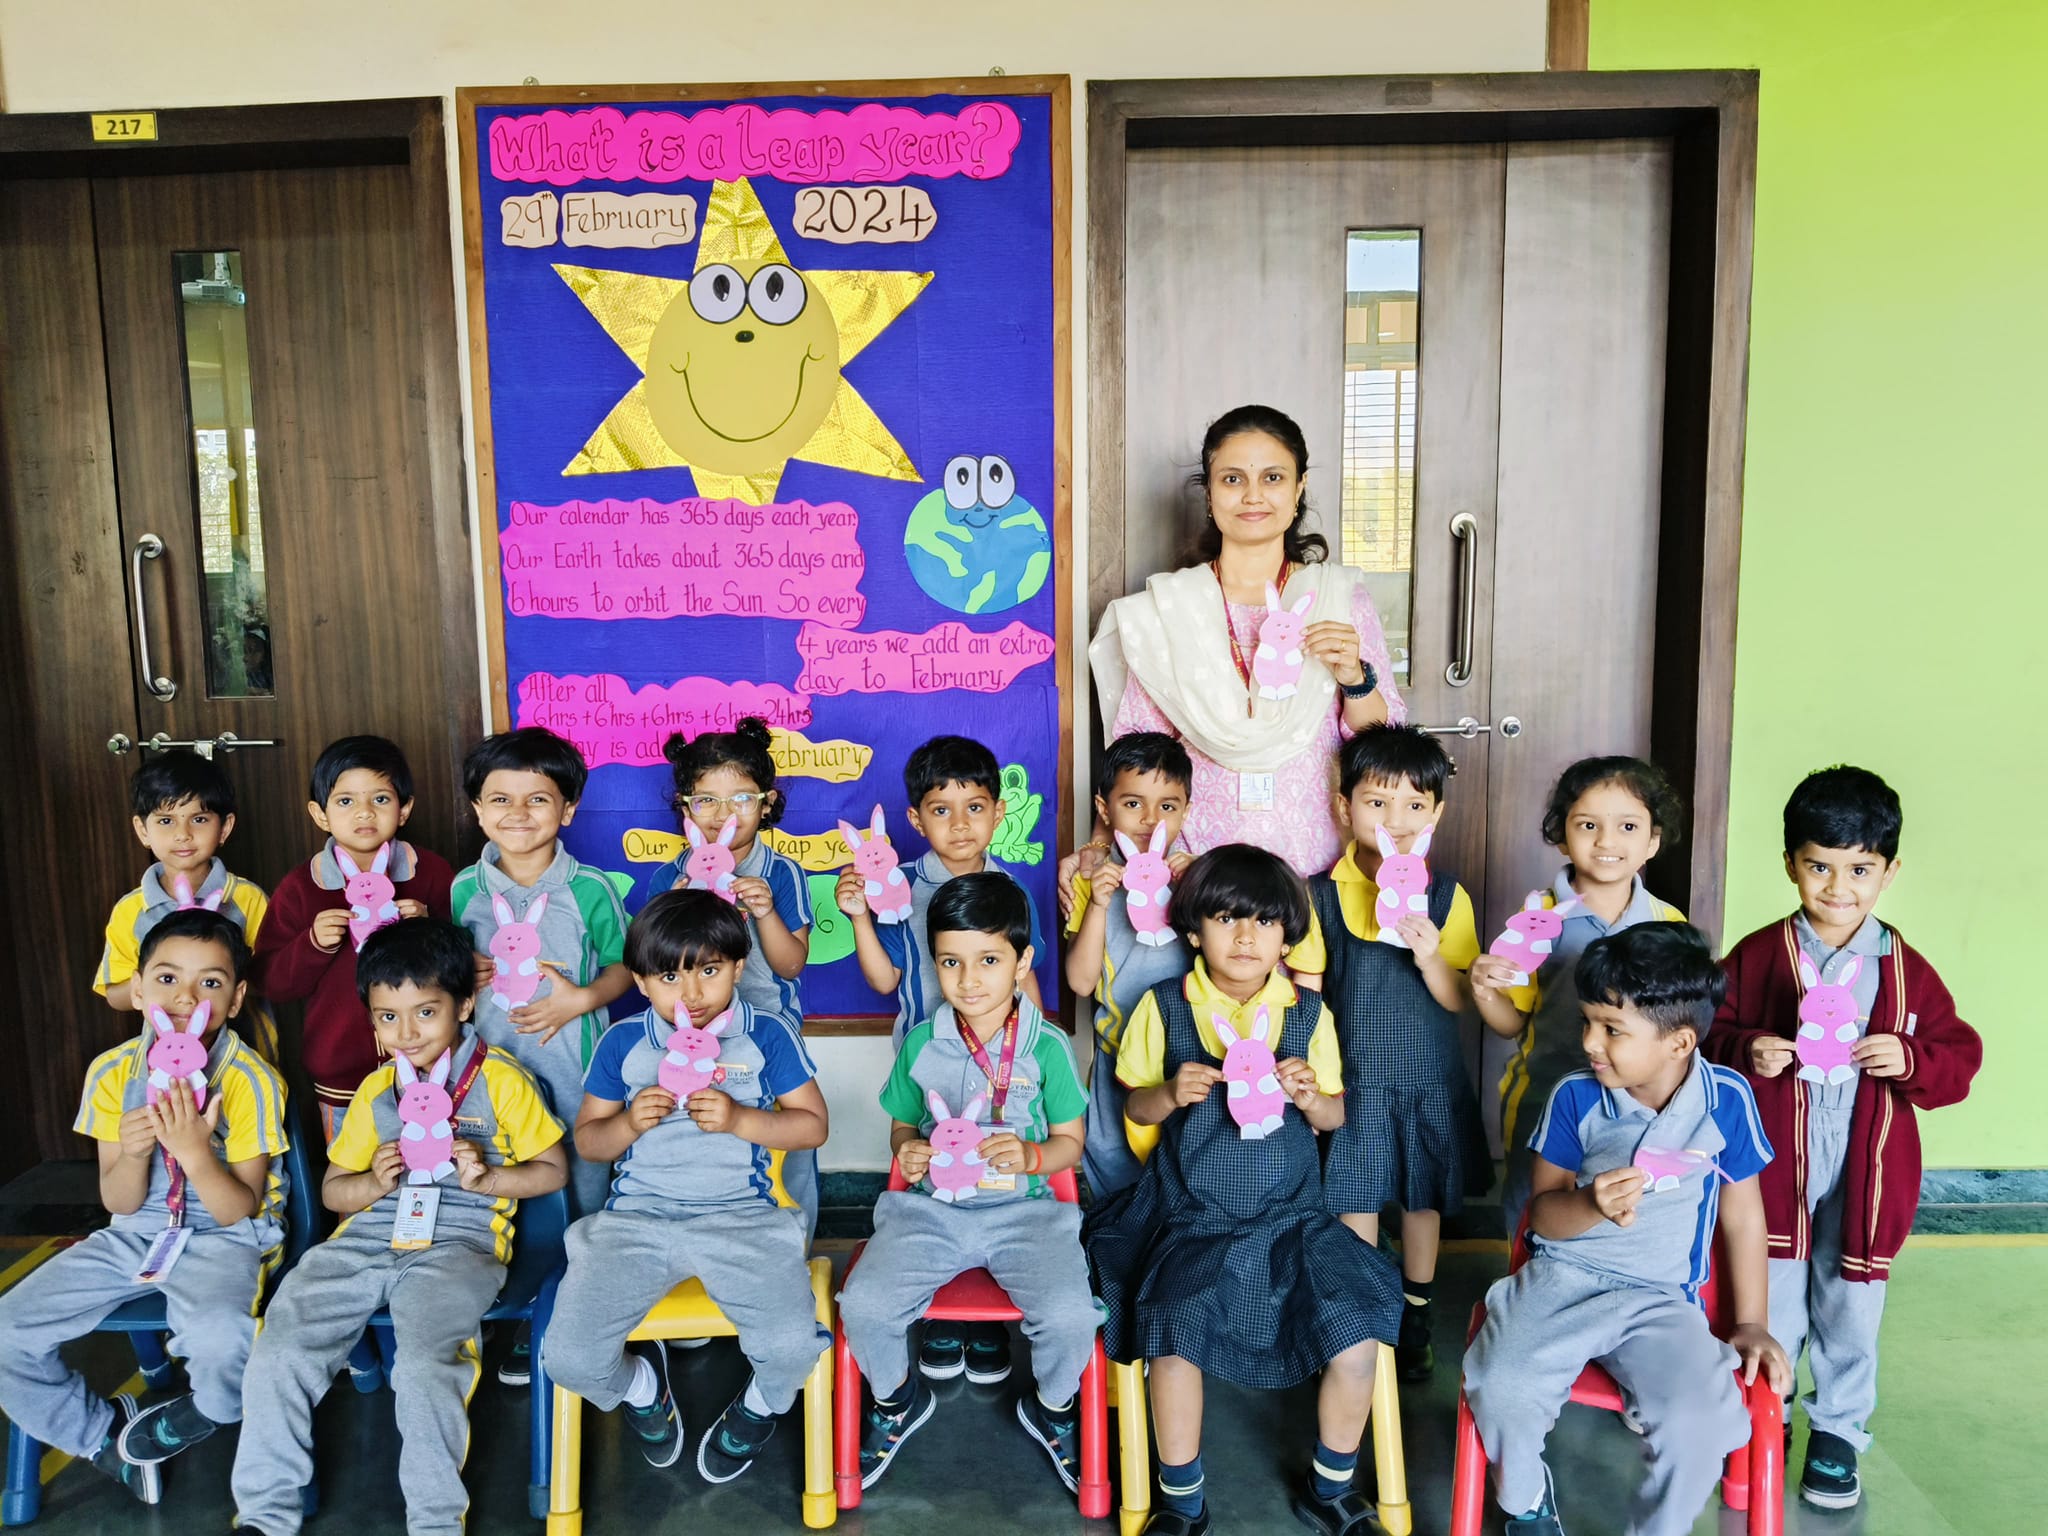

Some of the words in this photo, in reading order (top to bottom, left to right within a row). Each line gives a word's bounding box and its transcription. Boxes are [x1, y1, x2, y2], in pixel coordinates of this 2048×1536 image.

[106, 119, 142, 135] 217
[491, 117, 618, 173] What
[638, 127, 685, 173] is
[698, 134, 725, 170] a
[852, 104, 1003, 183] year?
[565, 197, 688, 246] February
[802, 187, 933, 239] 2024
[511, 502, 548, 526] Our
[559, 501, 630, 525] calendar
[640, 501, 670, 525] has
[679, 501, 719, 526] 365
[723, 502, 765, 534] days
[771, 503, 810, 526] each
[506, 543, 544, 570] Our
[554, 541, 602, 568] Earth
[612, 539, 662, 569] takes
[671, 541, 722, 568] about
[734, 542, 774, 568] 365
[778, 540, 825, 576] days
[831, 546, 864, 569] and
[528, 580, 580, 613] hours
[591, 580, 614, 613] to
[624, 585, 670, 613] orbit
[684, 582, 714, 613] the
[777, 578, 810, 613] So
[817, 596, 866, 627] every
[799, 625, 819, 653] 4
[813, 637, 878, 665] years
[884, 637, 911, 654] we
[922, 625, 960, 655] add
[968, 637, 990, 654] an
[1000, 627, 1051, 656] extra
[525, 673, 577, 702] After
[798, 658, 845, 694] day
[861, 656, 887, 690] to
[910, 652, 1007, 691] February.
[533, 703, 578, 728] 6hrs
[568, 729, 600, 768] ay
[609, 735, 628, 758] is
[625, 831, 669, 859] Our
